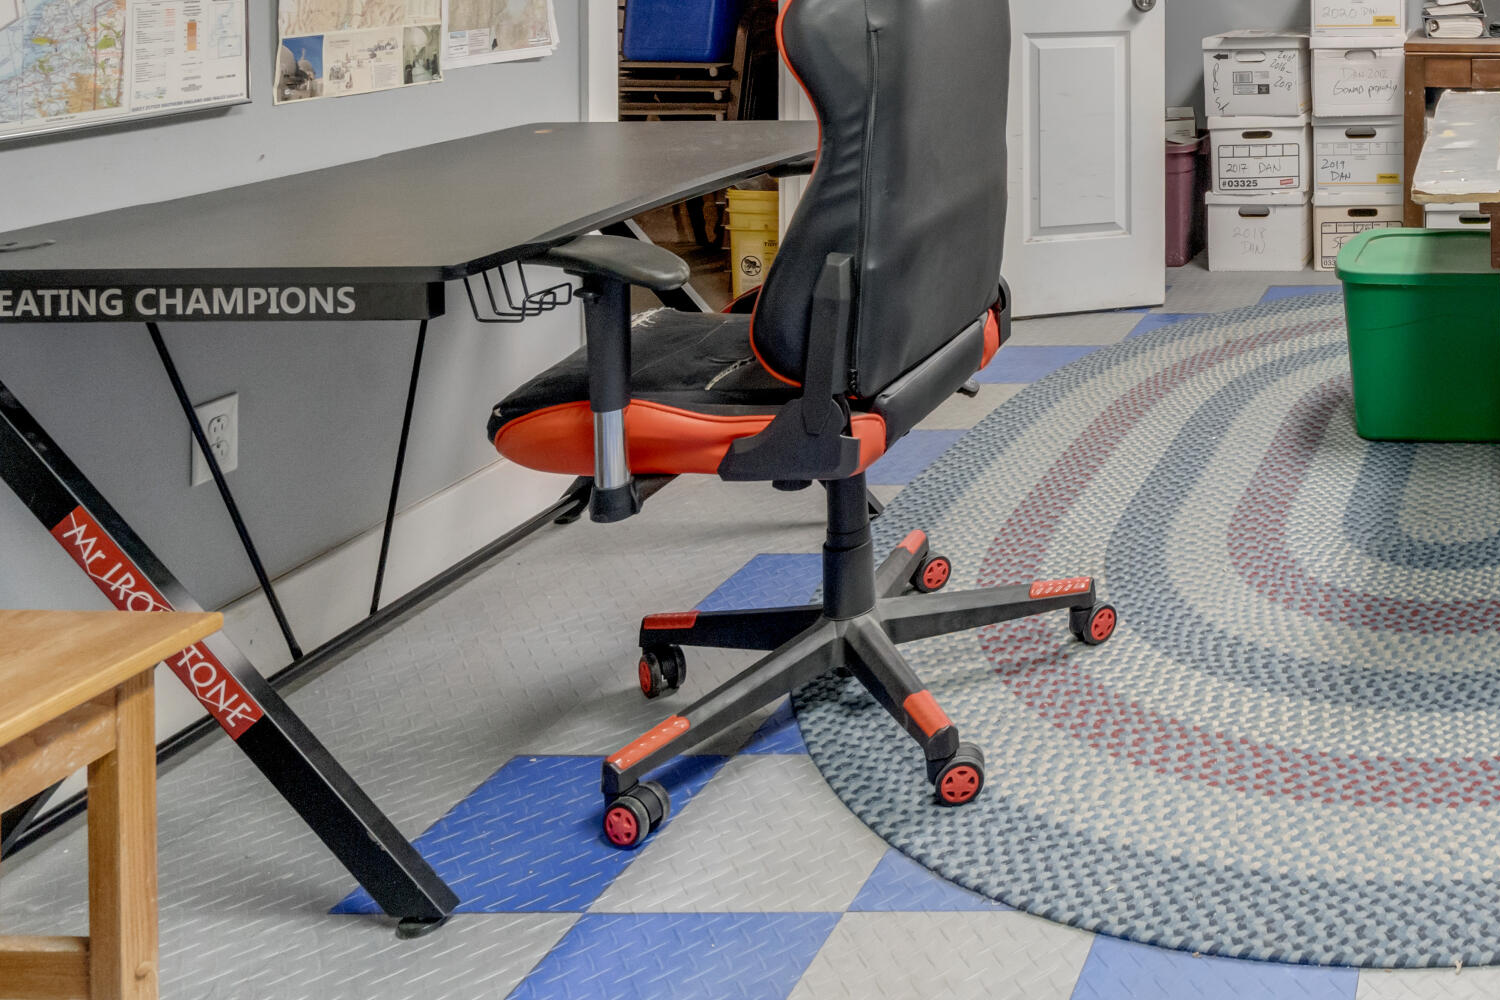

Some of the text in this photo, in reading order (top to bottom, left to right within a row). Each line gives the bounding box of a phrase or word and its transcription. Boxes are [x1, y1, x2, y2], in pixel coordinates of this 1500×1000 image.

[1226, 161, 1282, 174] 2017 DAN
[1320, 158, 1345, 170] 2019
[1330, 170, 1351, 182] DAN
[1222, 180, 1258, 188] #03325
[135, 286, 356, 316] CHAMPIONS
